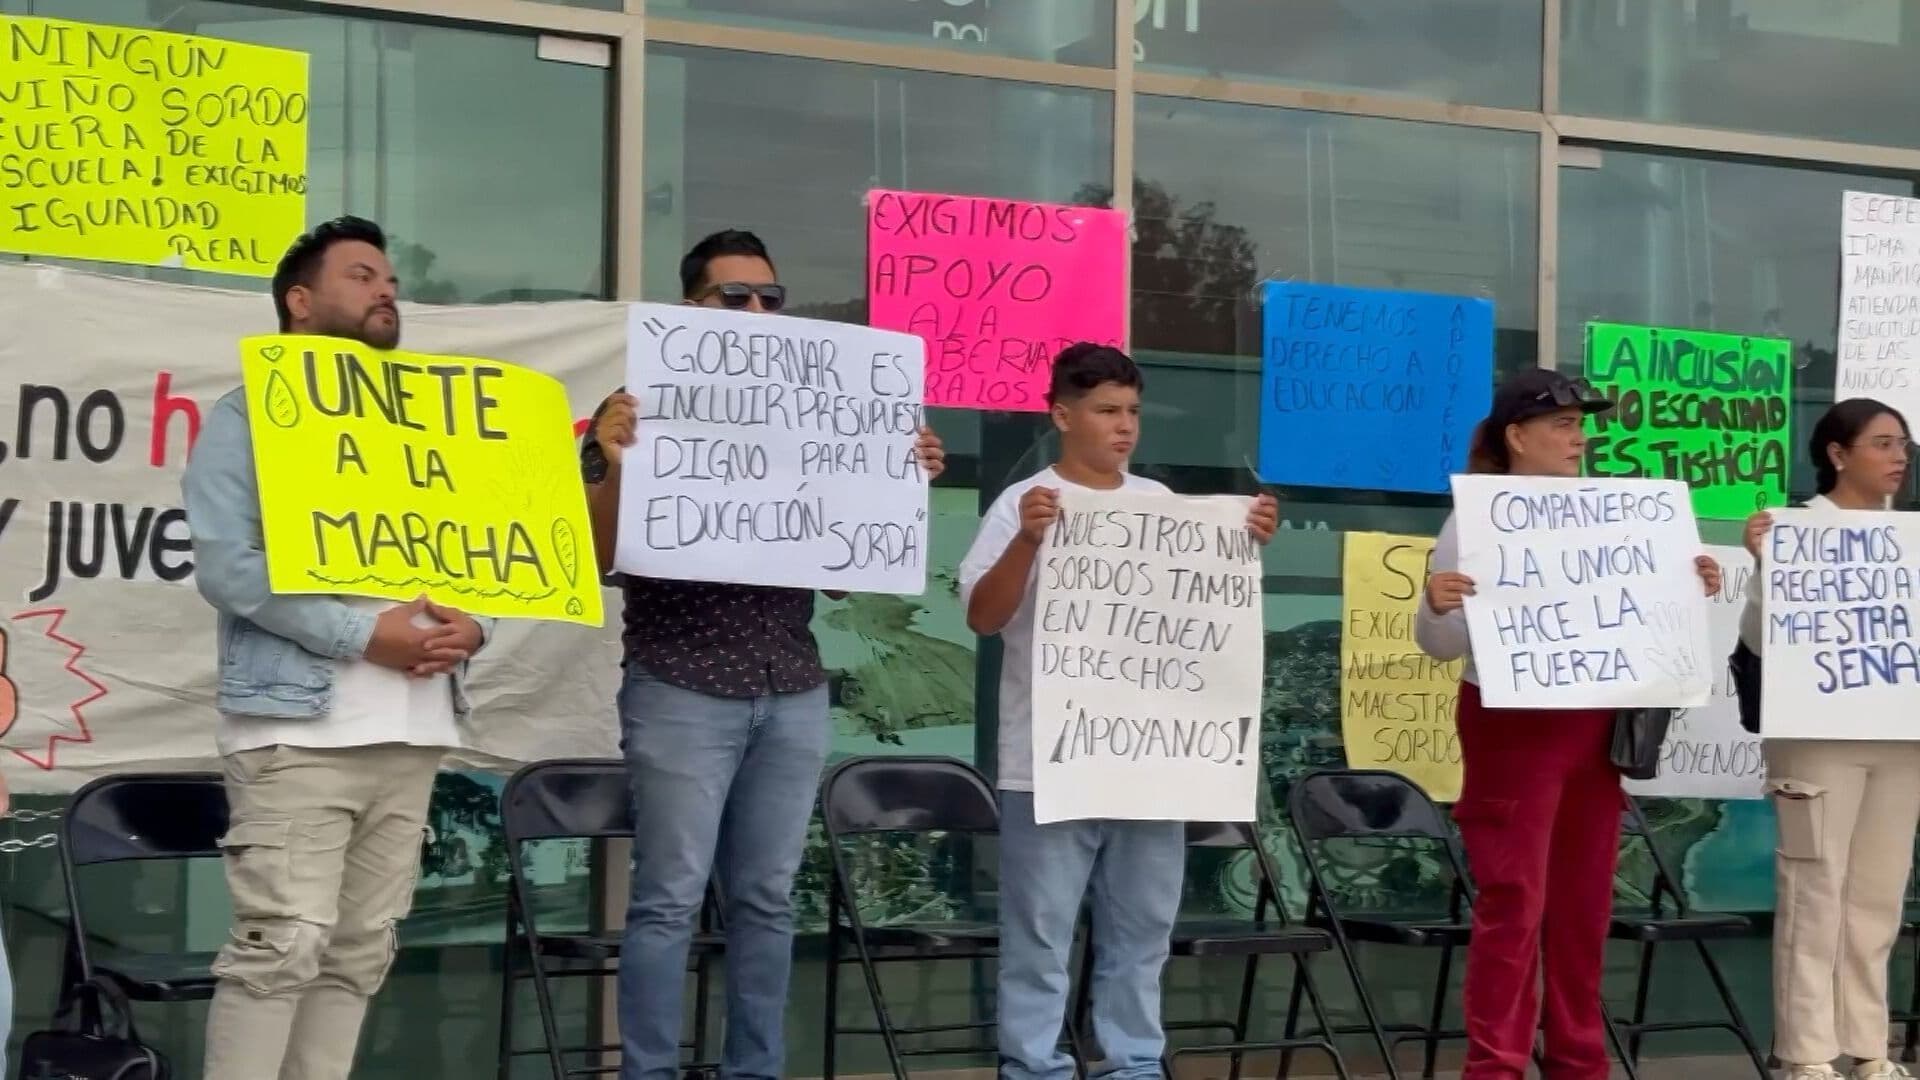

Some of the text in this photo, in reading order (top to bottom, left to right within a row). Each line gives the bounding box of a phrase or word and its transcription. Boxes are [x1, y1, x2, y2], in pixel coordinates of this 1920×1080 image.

[10, 23, 226, 81] NINGÚN
[161, 84, 307, 127] SORDO
[167, 128, 209, 158] DE
[236, 137, 280, 164] LA
[185, 164, 308, 195] EXIGIMOS
[874, 193, 1077, 243] EXIGIMOS
[168, 234, 272, 264] REAL
[875, 254, 1052, 302] APOYO
[1286, 294, 1418, 338] TENEMOS
[870, 352, 913, 399] ES
[1271, 336, 1425, 377] DERECHO A
[1585, 324, 1643, 383] LA
[640, 383, 793, 430] INCLUIR
[336, 433, 456, 493] A LA
[653, 435, 921, 486] DIGNO PARA LA
[644, 481, 825, 551] EDUCACIÓN
[1051, 510, 1206, 557] NUESTROS
[1490, 487, 1676, 533] COMPAÑEROS
[1497, 542, 1545, 589] LA
[1561, 535, 1658, 586] UNIÓN
[1772, 524, 1902, 566] EXIGIMOS
[1047, 556, 1154, 597] SORDOS
[1769, 566, 1889, 603] REGRESO
[1894, 566, 1914, 601] A
[1042, 599, 1233, 652] EN TIENEN
[1493, 587, 1647, 646] HACE LA
[1769, 603, 1913, 646] MAESTRA
[1041, 643, 1206, 693] DERECHOS
[1510, 647, 1639, 693] FUERZA
[1049, 698, 1253, 766] ¡APOYANOS!
